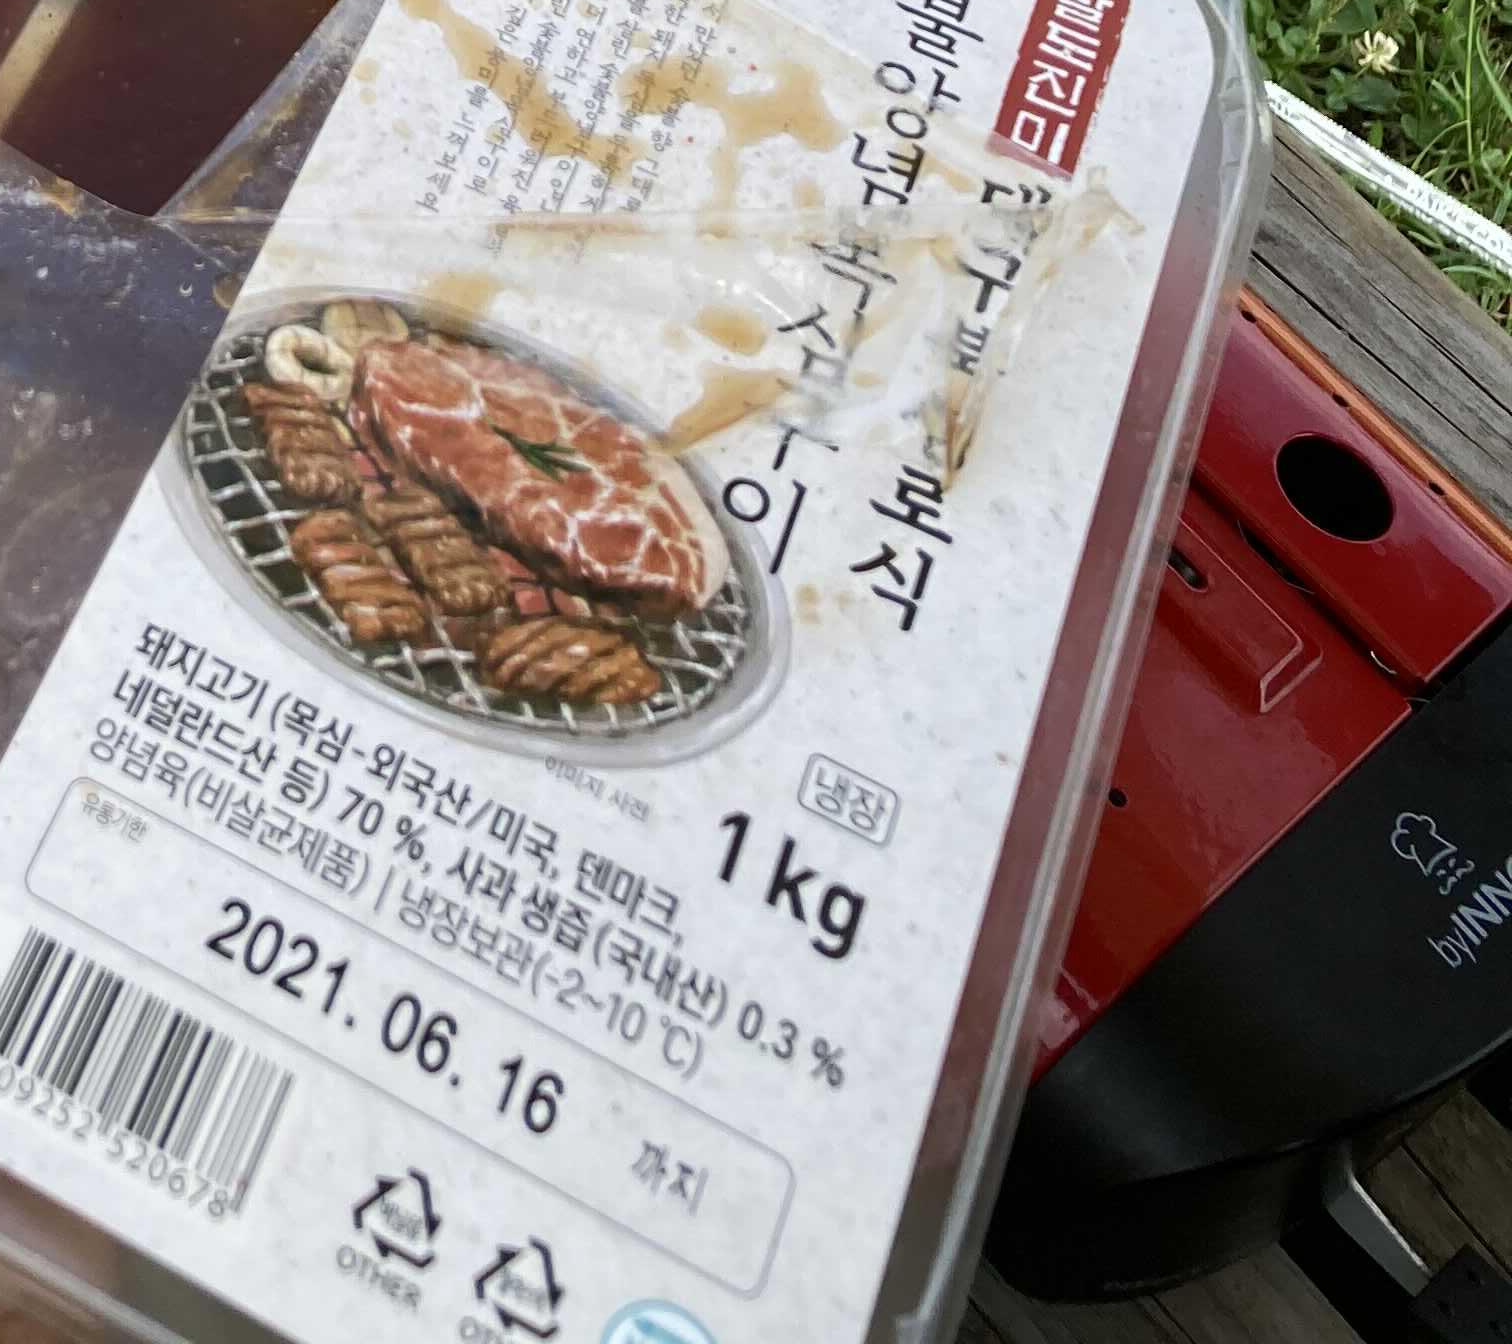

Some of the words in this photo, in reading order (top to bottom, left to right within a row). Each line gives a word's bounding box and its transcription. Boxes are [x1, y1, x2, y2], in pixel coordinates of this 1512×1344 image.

[493, 4, 528, 46] 깊은
[555, 25, 597, 85] 연하고
[606, 16, 641, 60] 살린
[642, 26, 676, 68] 돼지
[463, 44, 509, 110] 풍미를
[81, 792, 148, 844] 유통기한
[89, 717, 371, 897] 양념육(비살균제품)
[136, 622, 269, 720] 돼지고기
[574, 849, 683, 948] 덴마크,
[813, 766, 887, 832] 냉장
[113, 669, 277, 785] 네덜란드산
[280, 756, 330, 812] 등)
[337, 784, 386, 837] 70
[445, 846, 520, 913] 사과
[738, 999, 800, 1061] 0.3
[719, 810, 751, 883] 1
[764, 833, 867, 960] kg
[204, 895, 356, 1030] 2021.
[380, 991, 464, 1088] 06.
[495, 1054, 567, 1135] 16
[630, 1139, 711, 1217] 까지
[337, 1244, 422, 1311] OTHER
